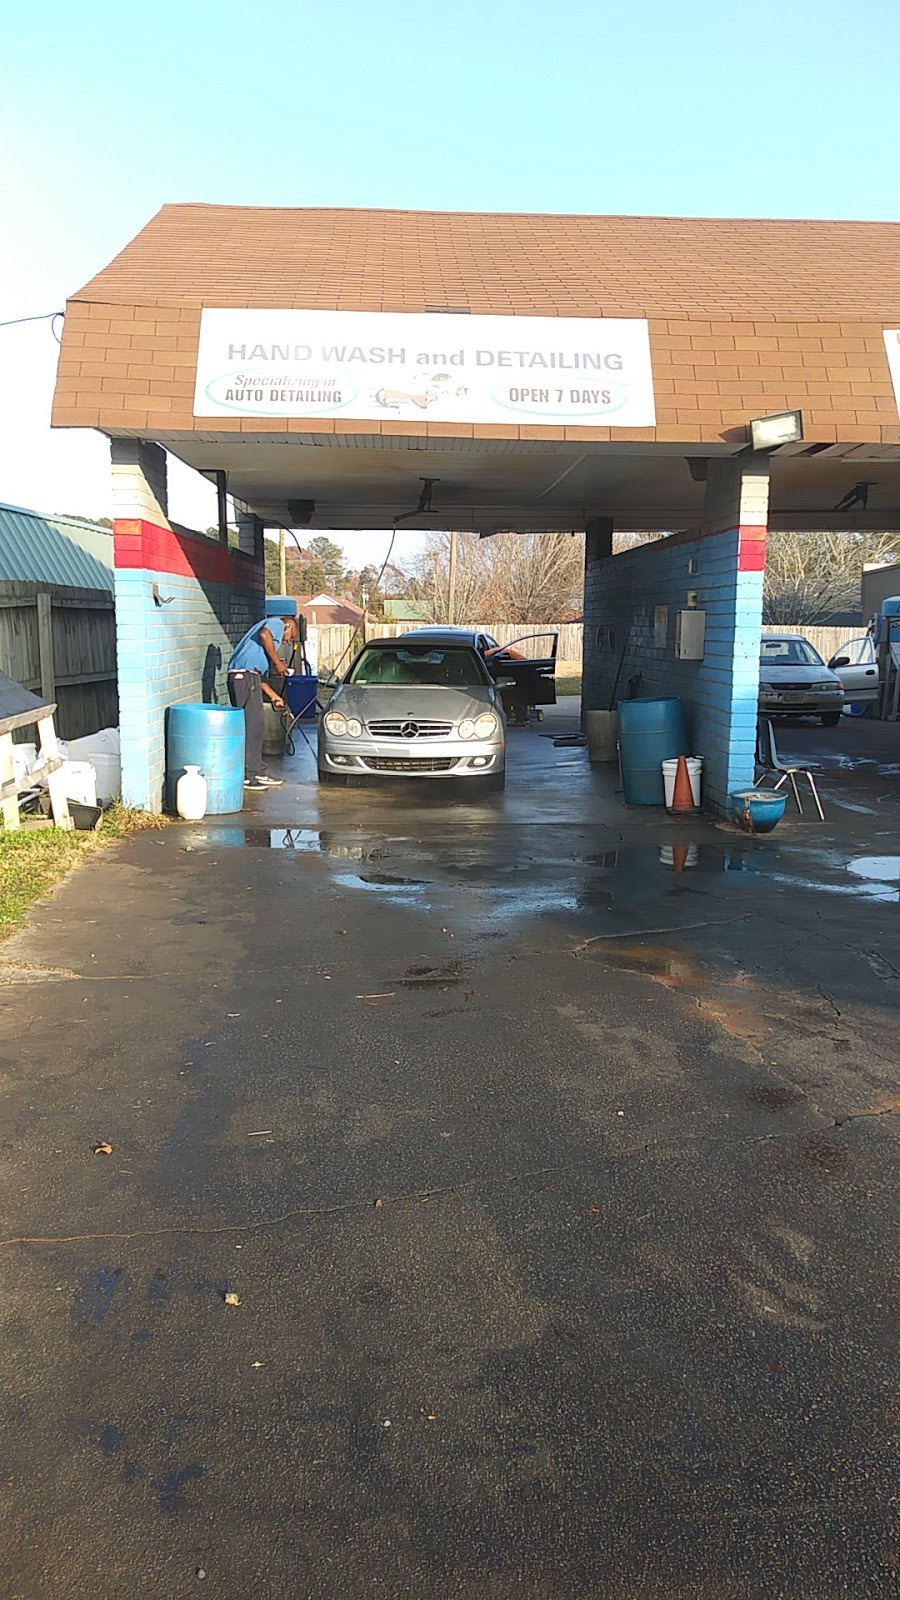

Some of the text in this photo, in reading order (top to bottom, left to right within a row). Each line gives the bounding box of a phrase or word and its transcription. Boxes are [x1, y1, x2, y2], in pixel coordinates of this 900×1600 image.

[227, 343, 624, 371] HAND WASH and DETAILING
[234, 374, 336, 389] Specializing in
[225, 389, 342, 403] AUTO DETAILING
[508, 387, 611, 404] OPEN 7 DAYS
